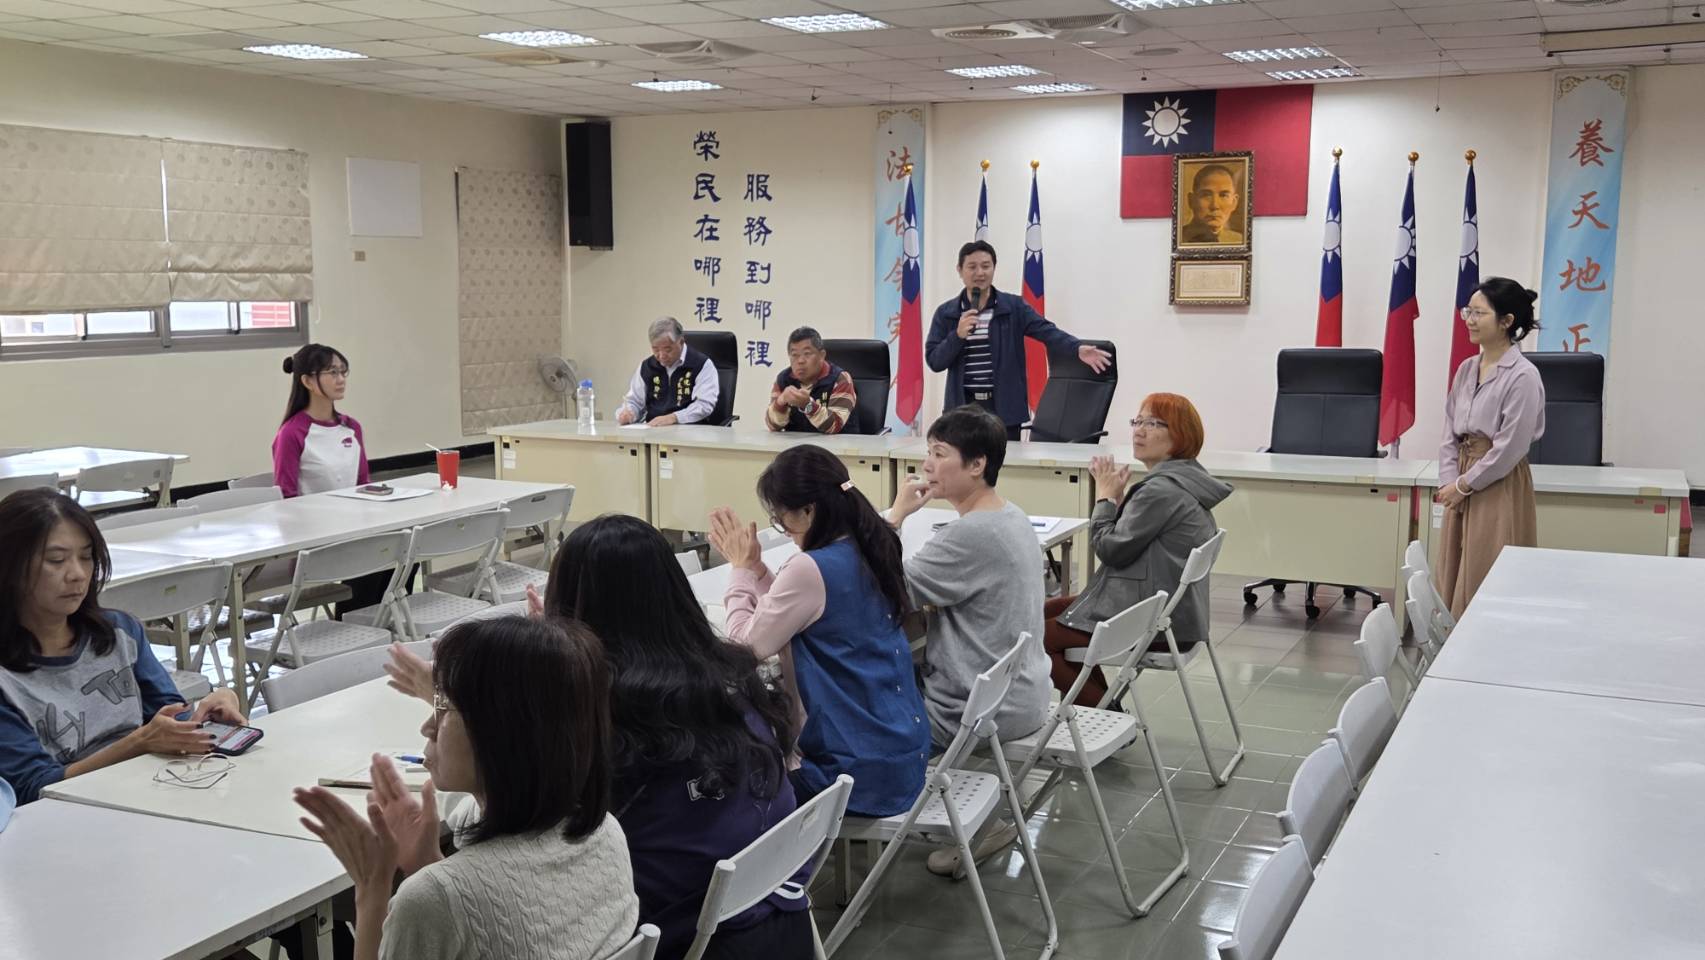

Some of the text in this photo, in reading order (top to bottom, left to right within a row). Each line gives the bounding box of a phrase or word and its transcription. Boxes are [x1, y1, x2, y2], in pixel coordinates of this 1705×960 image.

[693, 130, 722, 323] 榮民在哪裡
[744, 173, 773, 367] 服務到哪裡
